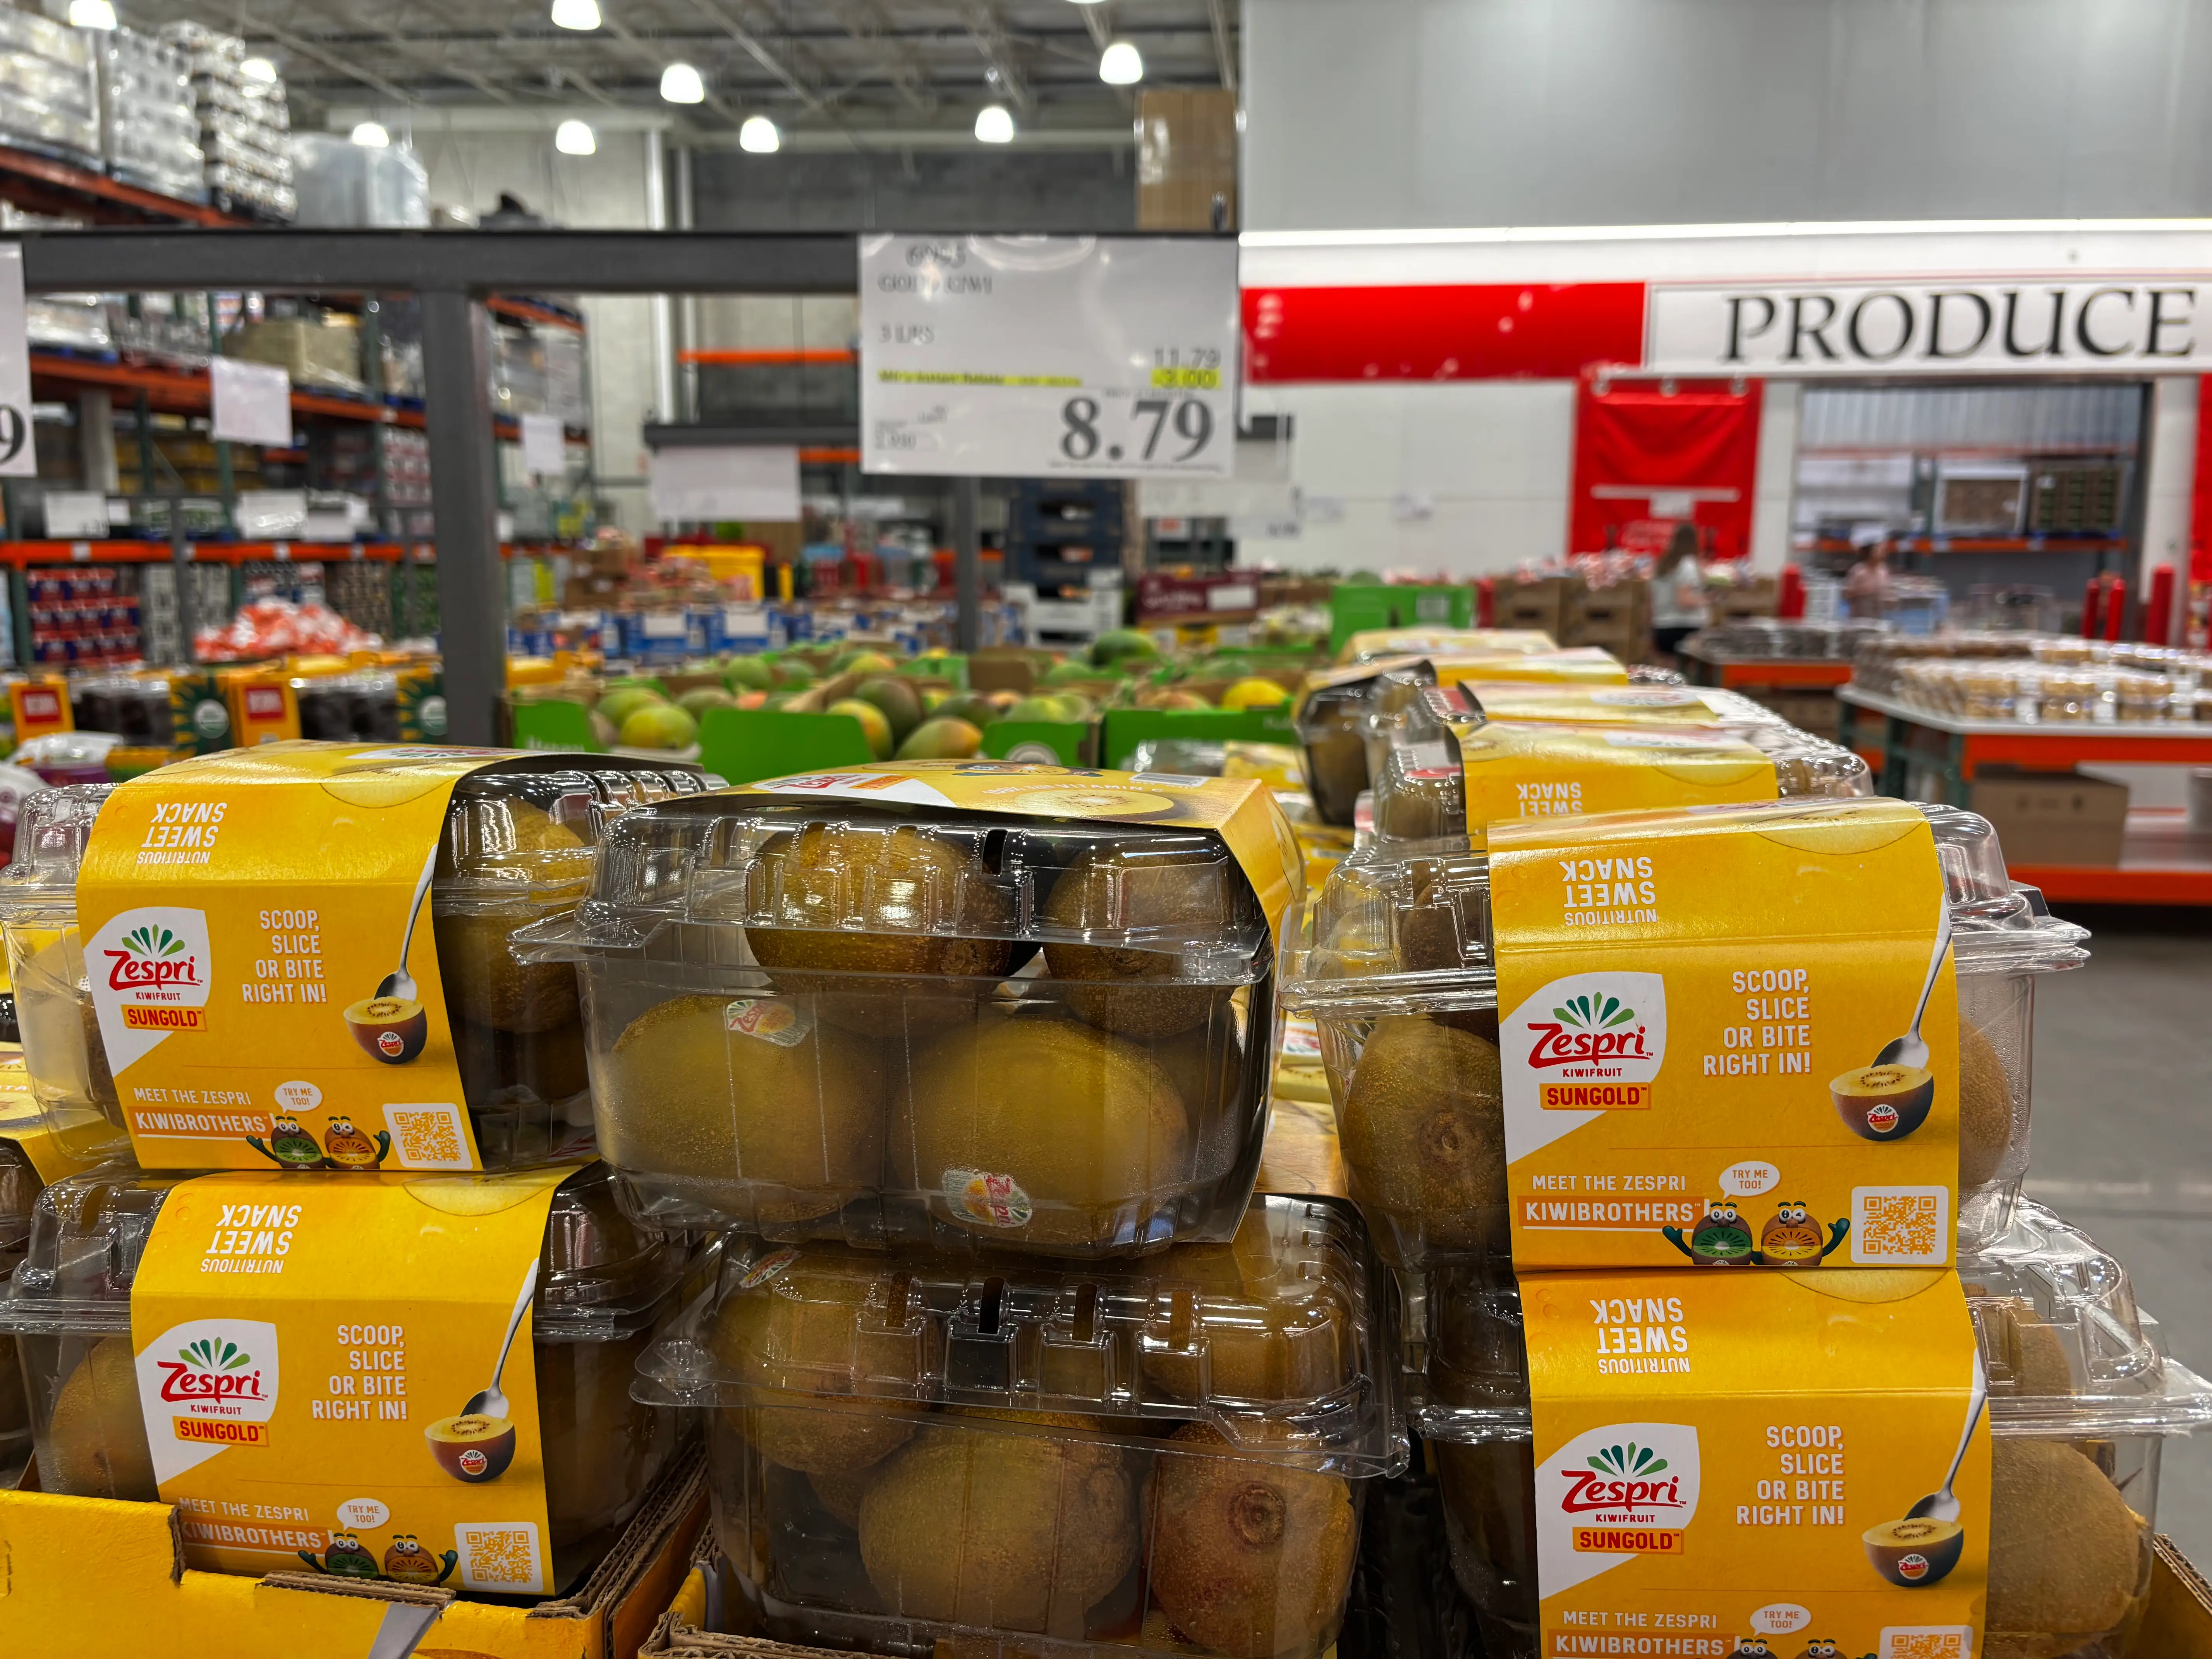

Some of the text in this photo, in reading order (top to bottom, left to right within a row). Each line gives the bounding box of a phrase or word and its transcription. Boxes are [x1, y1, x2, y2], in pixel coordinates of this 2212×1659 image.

[1720, 289, 2197, 363] PRODUCE
[1060, 397, 1215, 462] 8.79
[1516, 782, 1582, 800] SNACK
[151, 803, 227, 823] SNACK
[141, 826, 218, 847] SWEET
[137, 852, 210, 864] NUTRITIOUS
[1559, 857, 1652, 881] SNACK
[1564, 881, 1655, 907] SWEET
[260, 910, 319, 931] SCOOP,
[1565, 909, 1657, 926] NUTRITIOUS
[272, 935, 320, 953] SLICE
[256, 960, 323, 978] OR BITE
[1733, 969, 1808, 993] SCOOP,
[136, 992, 180, 1000] KIWIFRUIT
[242, 984, 326, 1002] RIGHT IN!
[1747, 997, 1809, 1020] SLICE
[1724, 1025, 1810, 1048] OR BITE
[1563, 1068, 1621, 1077] KIWIFRUIT
[1704, 1053, 1810, 1075] RIGHT IN!
[134, 1088, 250, 1104] MEET THE ZESPRI
[283, 1088, 313, 1097] TRY ME
[290, 1098, 310, 1106] TOO!
[1533, 1176, 1685, 1190] MEET THE ZESPRI
[1733, 1170, 1767, 1178] TRY ME
[1740, 1180, 1762, 1189] TOO!
[216, 1205, 302, 1228] SNACK
[206, 1231, 292, 1255] SWEET
[201, 1259, 283, 1273] NUTRITIOUS
[1590, 1298, 1683, 1324] SNACK
[338, 1325, 404, 1347] SCOOP,
[1597, 1326, 1687, 1353] SWEET
[350, 1351, 404, 1370] SLICE
[1599, 1358, 1690, 1374] NUTRITIOUS
[330, 1376, 405, 1395] OR BITE
[191, 1405, 240, 1414] KIWIFRUIT
[313, 1400, 406, 1419] RIGHT IN!
[1767, 1426, 1843, 1449] SCOOP,
[1781, 1454, 1843, 1474] SLICE
[1758, 1480, 1843, 1499] OR BITE
[179, 1497, 309, 1521] MEET THE ZESPRI
[1737, 1506, 1843, 1524] RIGHT IN!
[356, 1515, 374, 1523] TOO!
[1564, 1612, 1716, 1627] MEET THE ZESPRI
[1764, 1611, 1799, 1620] TRY ME
